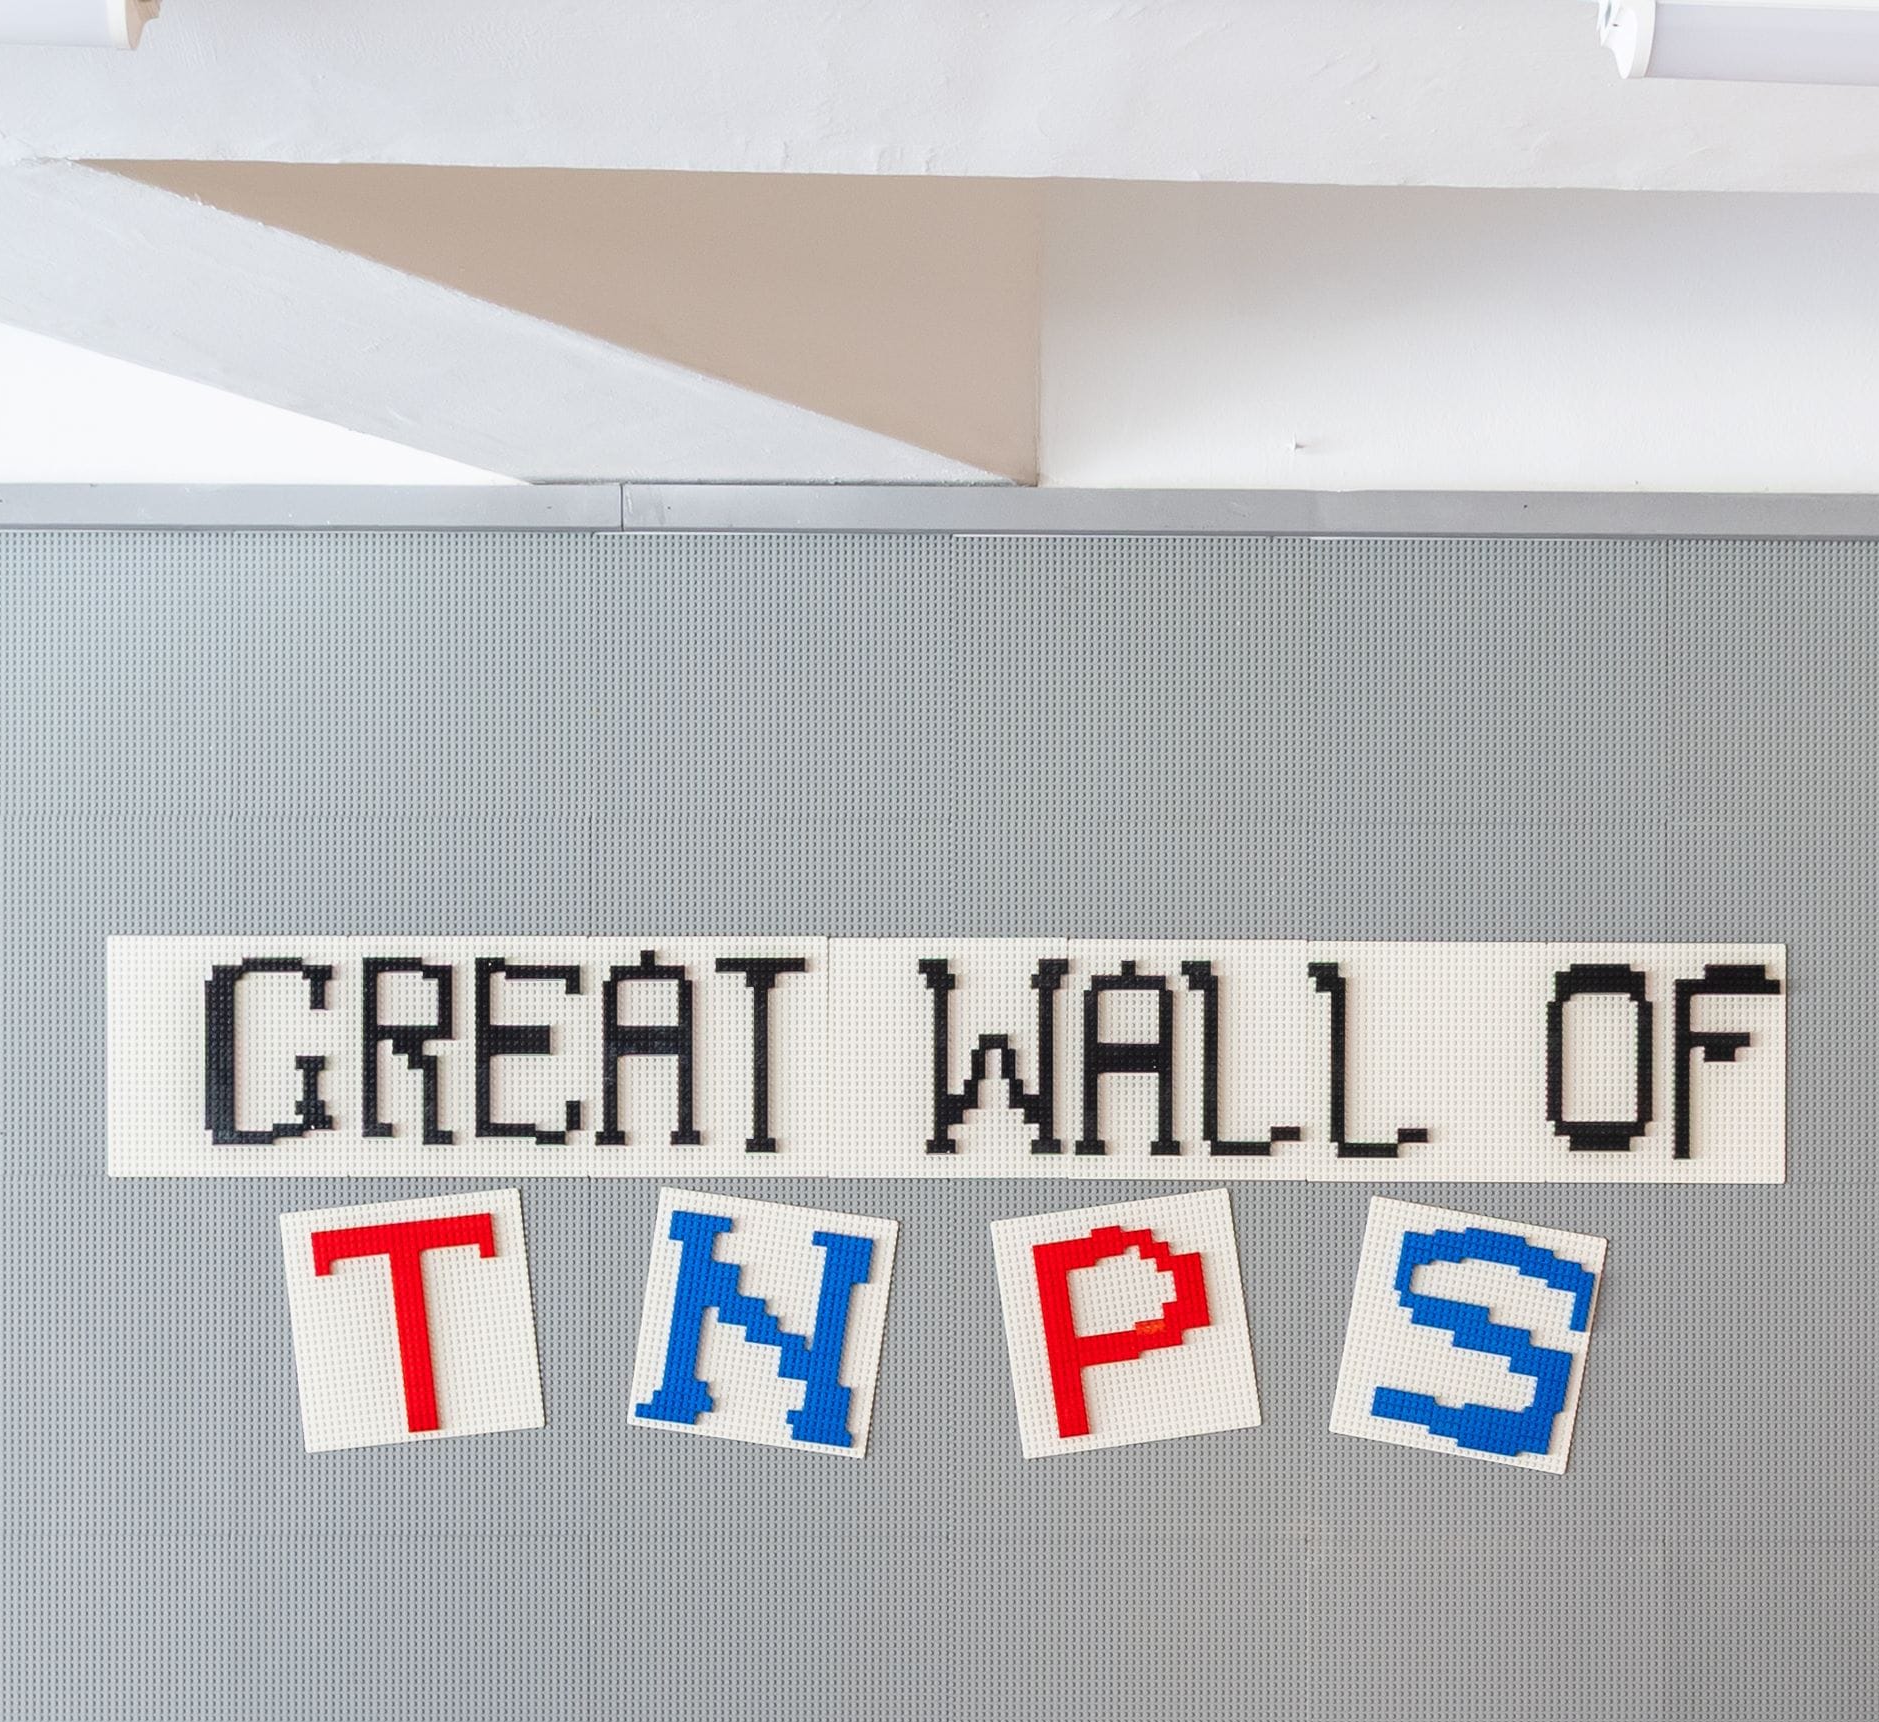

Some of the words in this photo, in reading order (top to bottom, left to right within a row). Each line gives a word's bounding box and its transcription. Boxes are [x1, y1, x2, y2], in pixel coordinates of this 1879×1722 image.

[204, 950, 806, 1152] GREAT
[918, 958, 1428, 1158] WALL
[1547, 963, 1782, 1159] OF
